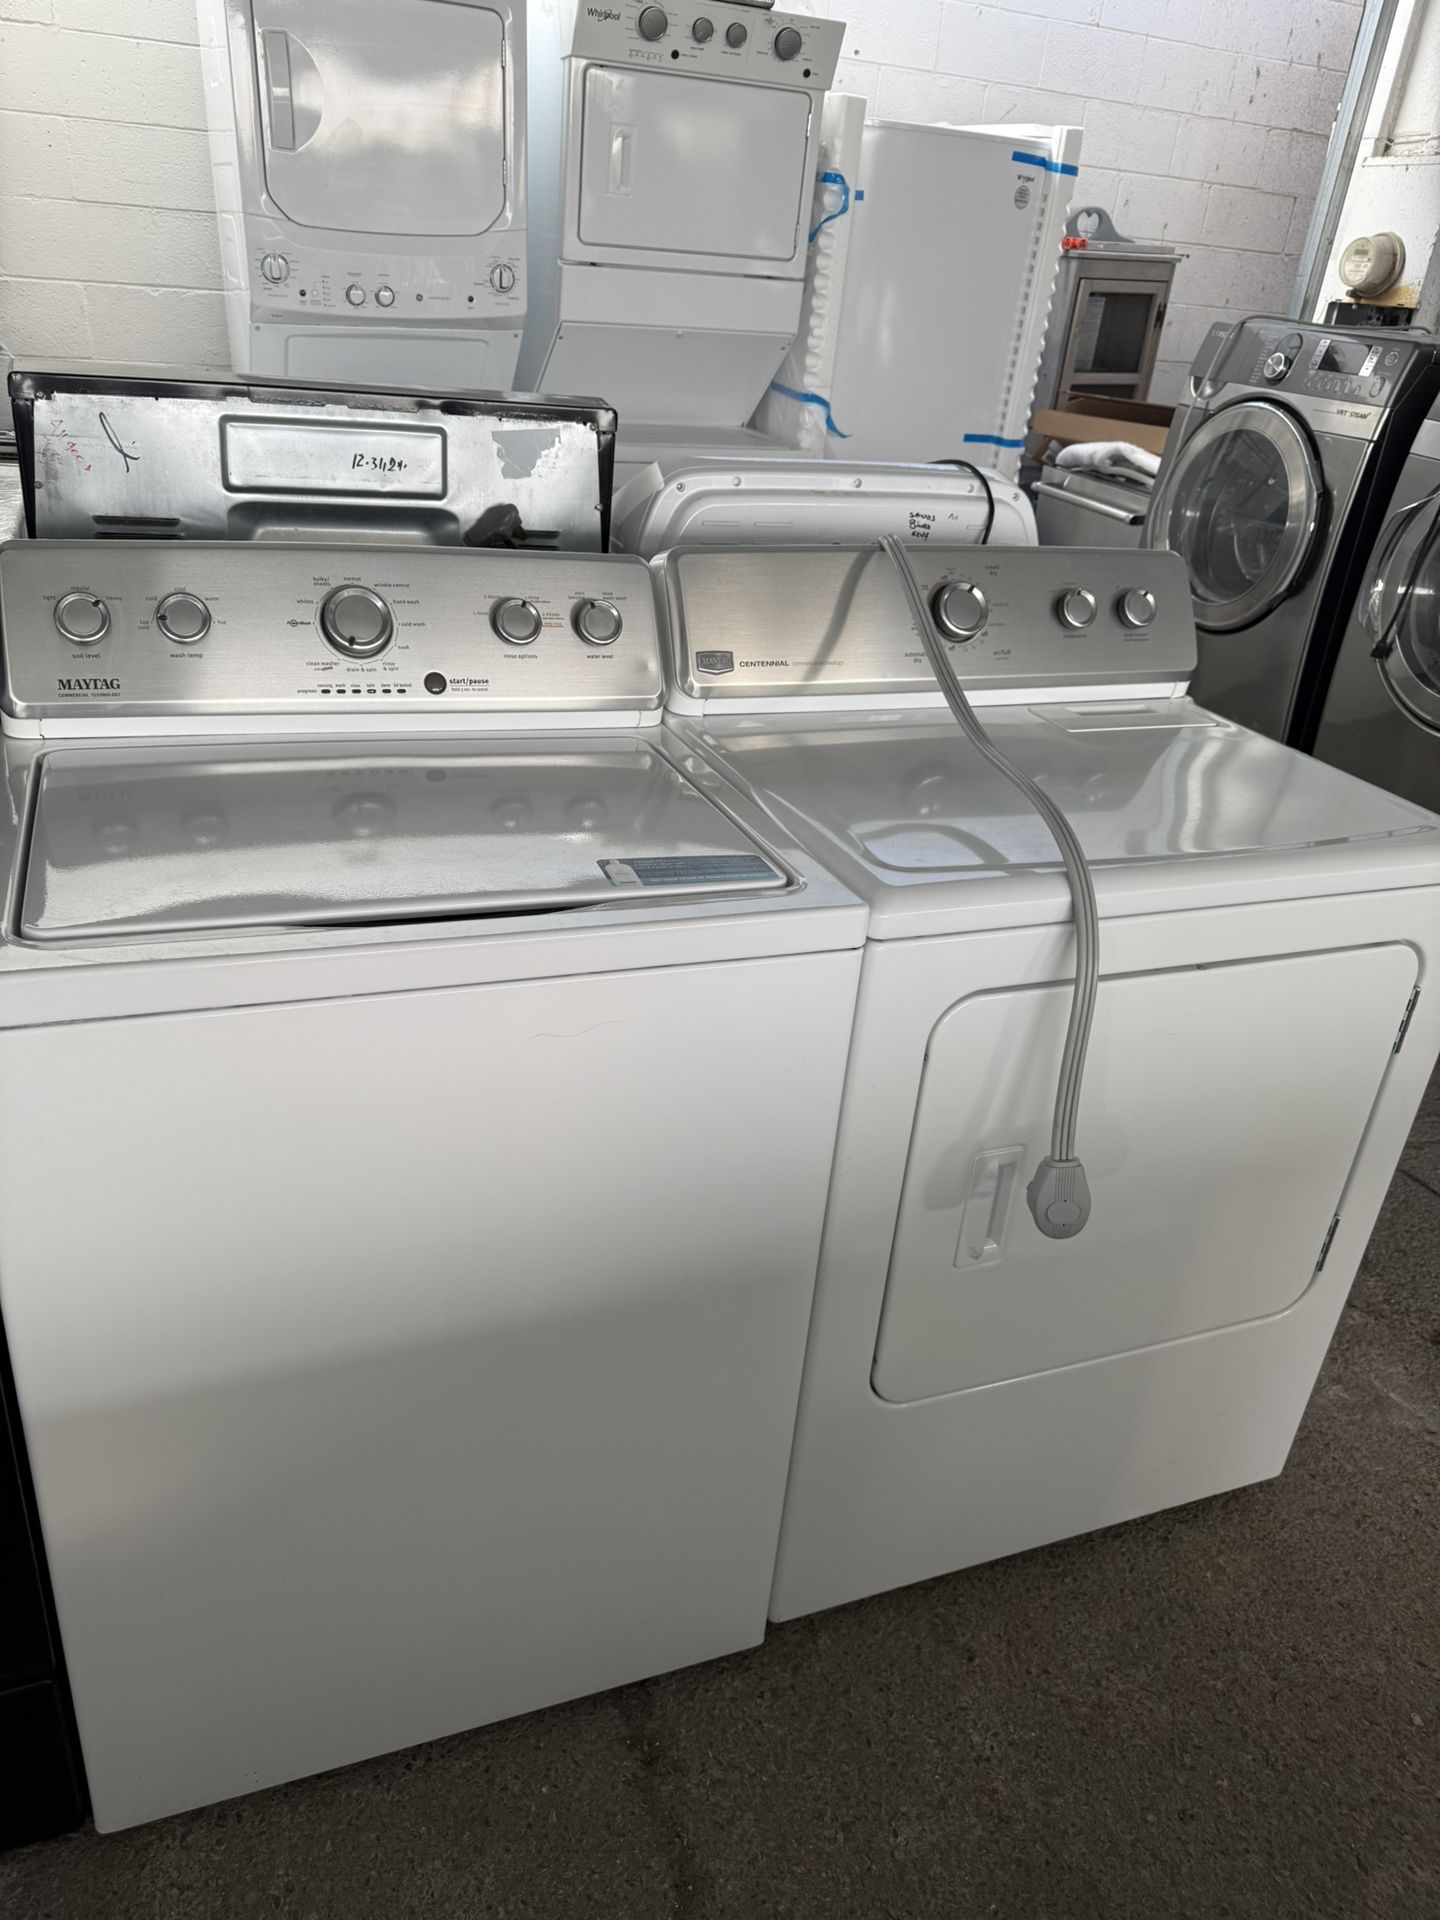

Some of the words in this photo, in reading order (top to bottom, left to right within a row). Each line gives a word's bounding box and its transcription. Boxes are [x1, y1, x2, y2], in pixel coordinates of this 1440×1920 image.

[587, 7, 621, 22] Whirlpool
[739, 660, 790, 668] CENTENNIAL
[57, 678, 121, 691] MAYTAG
[449, 677, 490, 686] start/pause
